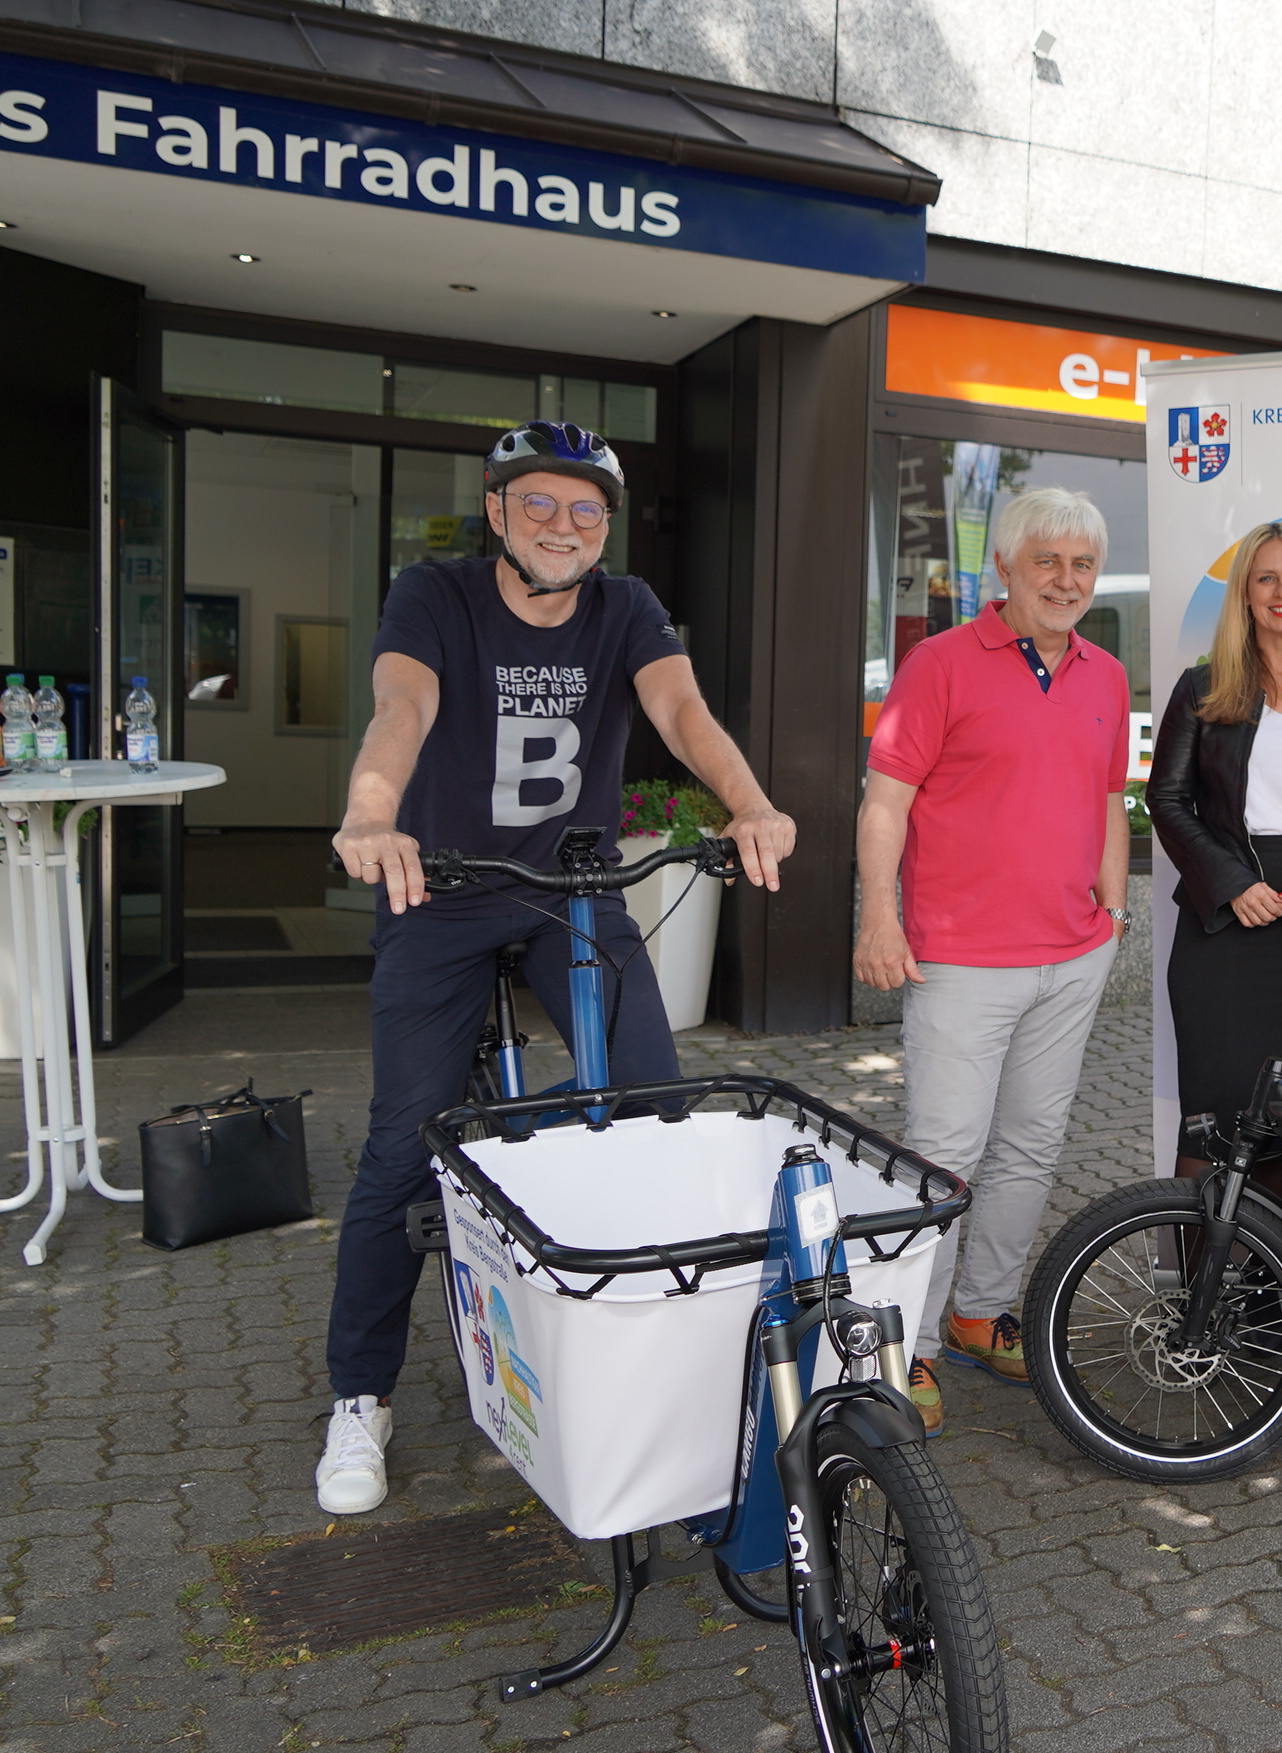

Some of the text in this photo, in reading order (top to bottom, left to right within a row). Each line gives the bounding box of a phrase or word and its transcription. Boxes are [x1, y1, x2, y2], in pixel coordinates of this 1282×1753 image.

[97, 89, 681, 237] Fahrradhaus
[495, 665, 588, 683] BECAUSE
[496, 681, 588, 695] THERE IS NO
[497, 695, 588, 717] PLANET
[492, 715, 582, 827] B
